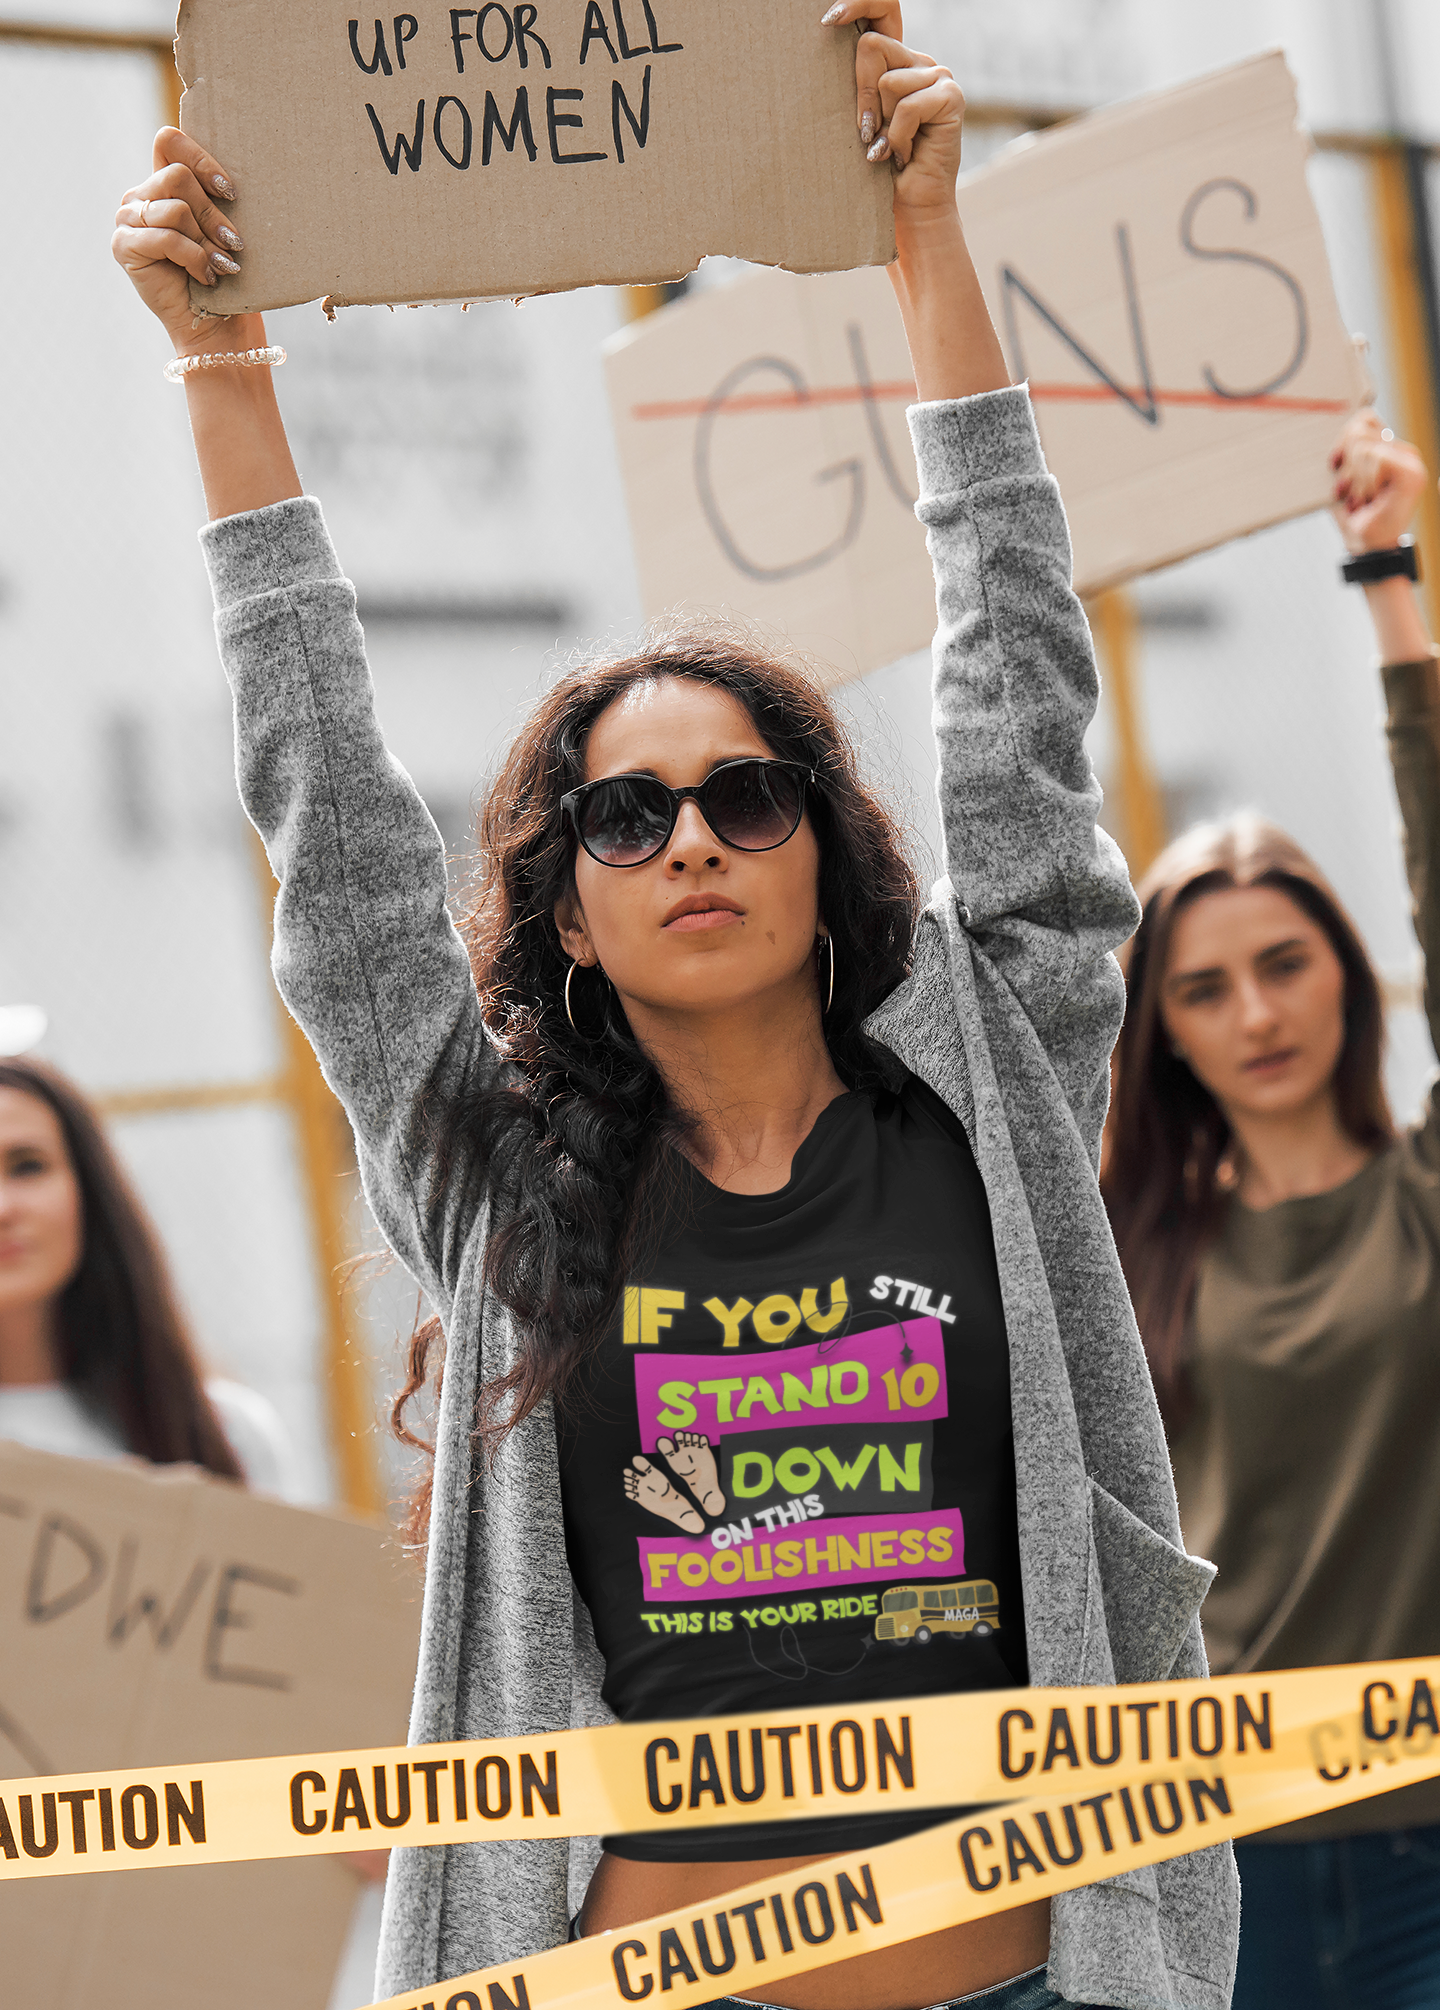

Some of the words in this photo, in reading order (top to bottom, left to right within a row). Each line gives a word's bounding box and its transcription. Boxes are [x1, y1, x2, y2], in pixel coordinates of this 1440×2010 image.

[348, 14, 419, 76] UP
[449, 2, 552, 73] FOR
[579, 0, 684, 65] ALL
[365, 65, 652, 175] WOMEN
[623, 1286, 685, 1344] IF
[702, 1277, 849, 1348] YOU
[869, 1275, 957, 1325] STILL
[656, 1360, 869, 1429] STAND
[732, 1442, 922, 1498] DOWN
[646, 1526, 954, 1589] FOOLISHNESS
[711, 1517, 754, 1550] ON
[754, 1494, 825, 1533] THIS
[0, 1499, 303, 1694] DWE
[640, 1613, 703, 1633] THIS
[709, 1611, 733, 1630] IS
[740, 1601, 817, 1629] YOUR
[822, 1594, 878, 1620] RIDE
[943, 1607, 980, 1622] MAGA
[289, 1750, 561, 1836] CAUTION
[644, 1716, 916, 1815] CAUTION
[999, 1692, 1272, 1780] CAUTION
[611, 1864, 885, 2002] CAUTION
[959, 1777, 1233, 1893] CAUTION
